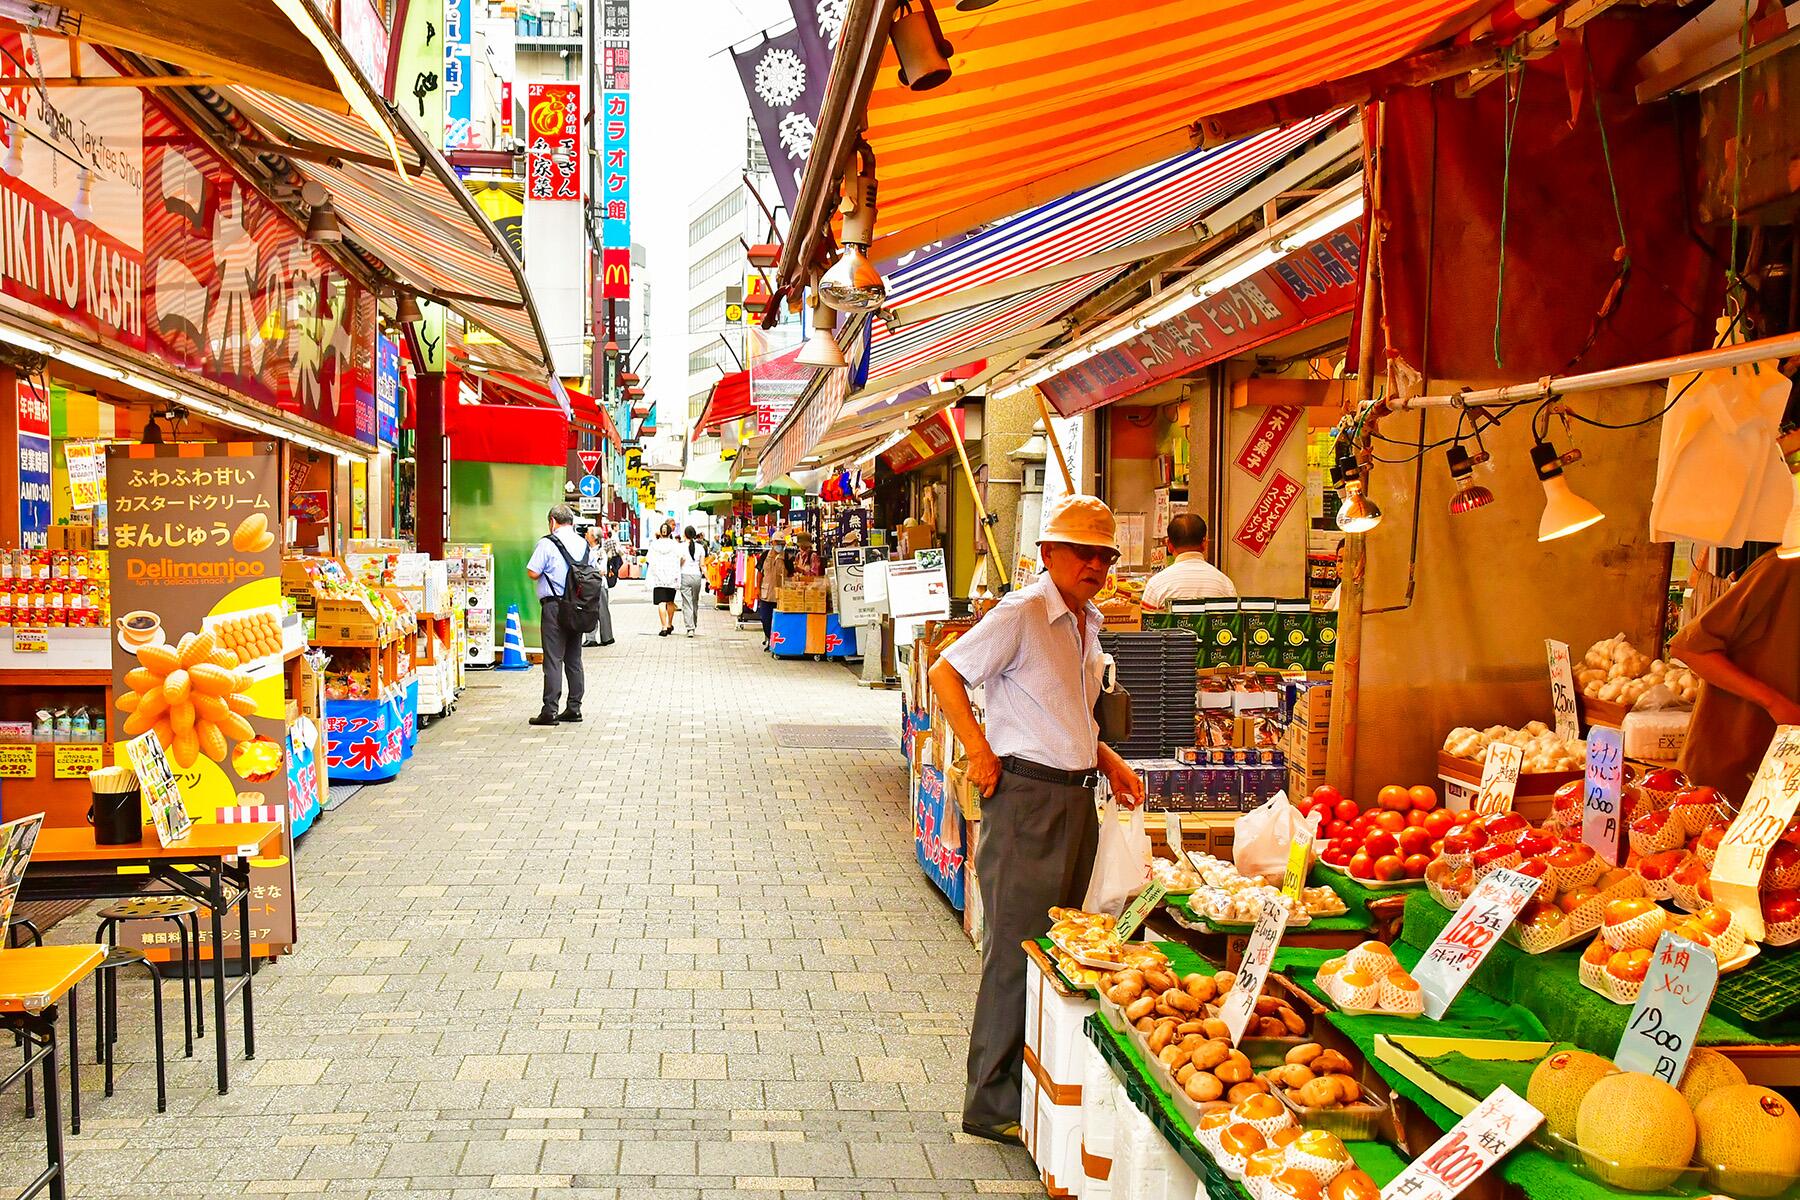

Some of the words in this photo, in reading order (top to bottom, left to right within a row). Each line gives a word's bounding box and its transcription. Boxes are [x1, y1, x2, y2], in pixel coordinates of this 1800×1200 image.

[529, 85, 544, 96] 2F
[607, 97, 628, 221] カラオケ館
[42, 209, 79, 309] NO
[84, 233, 142, 337] KASHI
[19, 395, 48, 424] 年中無休
[1246, 404, 1293, 469] 二木の菓子
[20, 448, 49, 474] 営業時間
[128, 467, 256, 488] ふわふわ甘い
[115, 494, 271, 512] カスタードクリーム
[114, 521, 231, 549] まんじゅう
[127, 555, 265, 583] Delimanjoo
[1553, 682, 1576, 714] 2500
[1490, 744, 1517, 766] トマト
[1591, 743, 1618, 764] シナノ
[1586, 787, 1614, 814] 1300
[1603, 817, 1616, 843] 円
[1441, 905, 1494, 949] 1000
[1465, 948, 1483, 970] 円
[1660, 943, 1690, 973] 赤肉
[1654, 973, 1704, 1006] メロン
[1630, 1007, 1682, 1052] 1200
